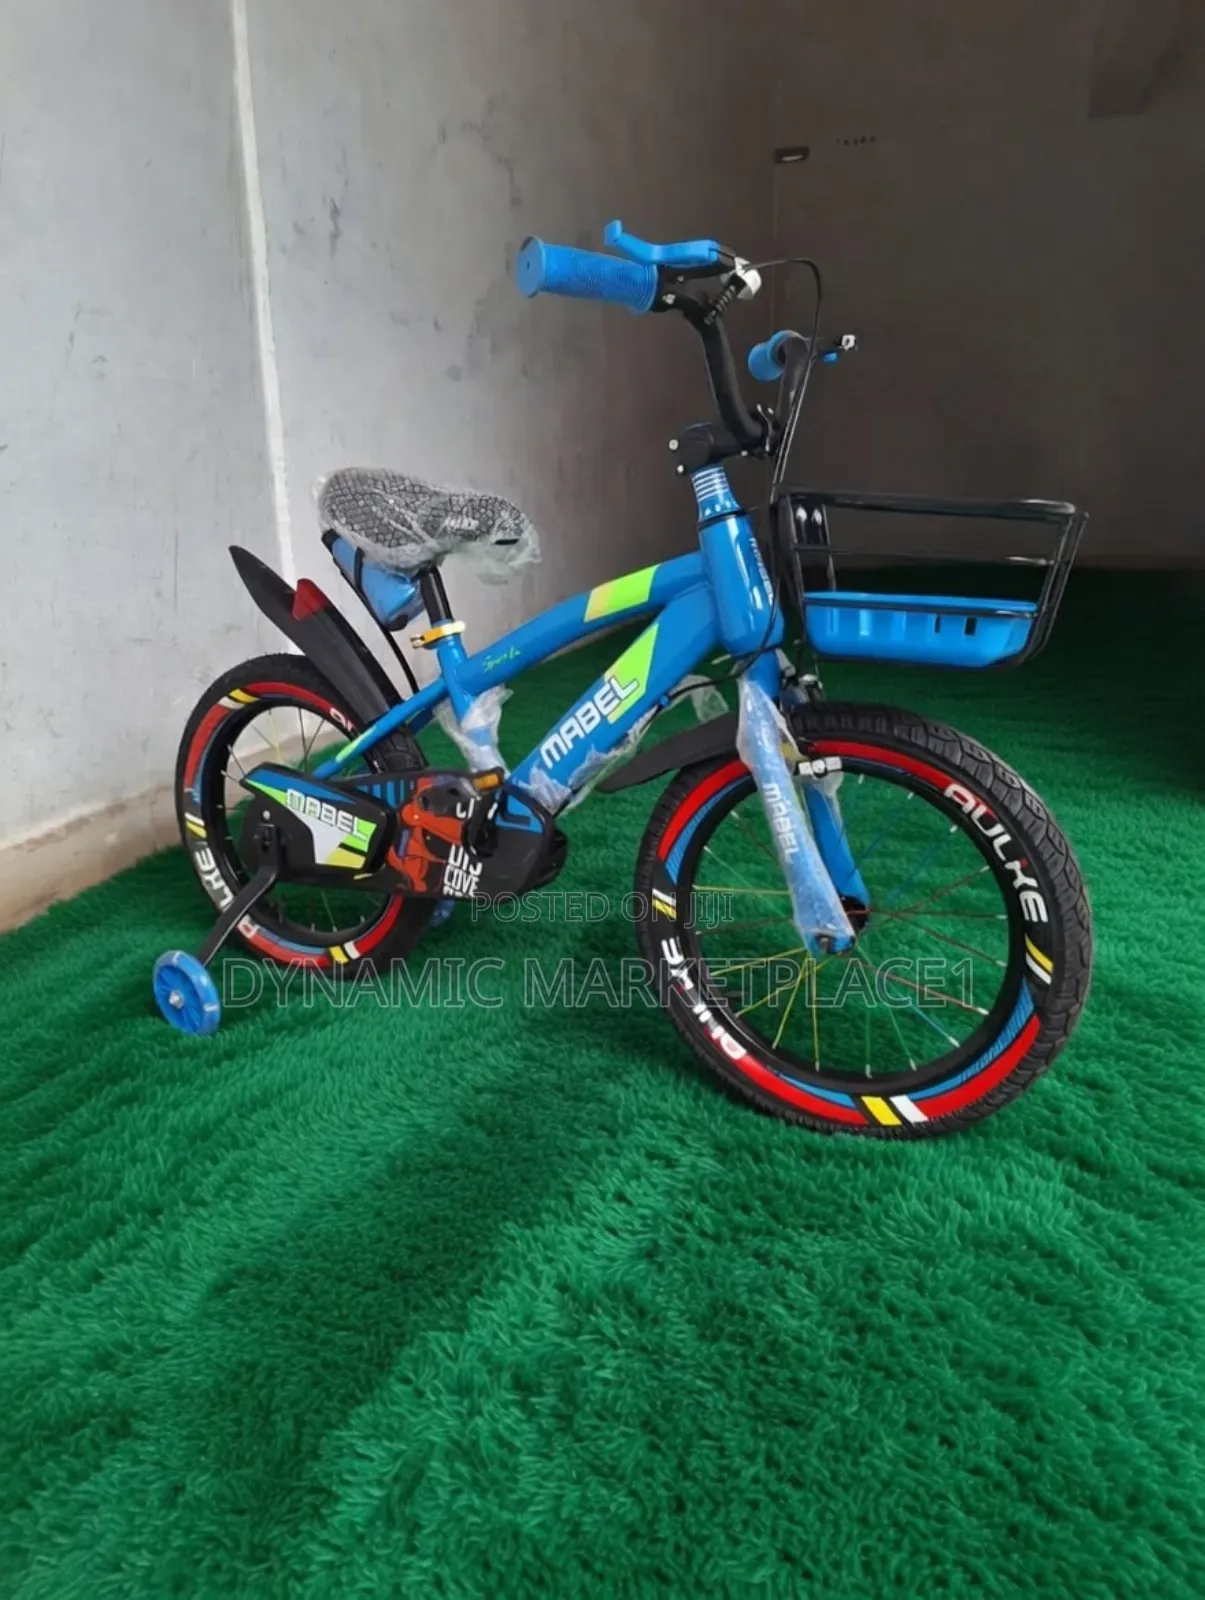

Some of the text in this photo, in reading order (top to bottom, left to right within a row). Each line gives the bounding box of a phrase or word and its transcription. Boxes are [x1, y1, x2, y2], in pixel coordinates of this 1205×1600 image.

[539, 675, 639, 769] MABEL
[286, 788, 369, 842] MABEL
[762, 782, 800, 862] MABEL
